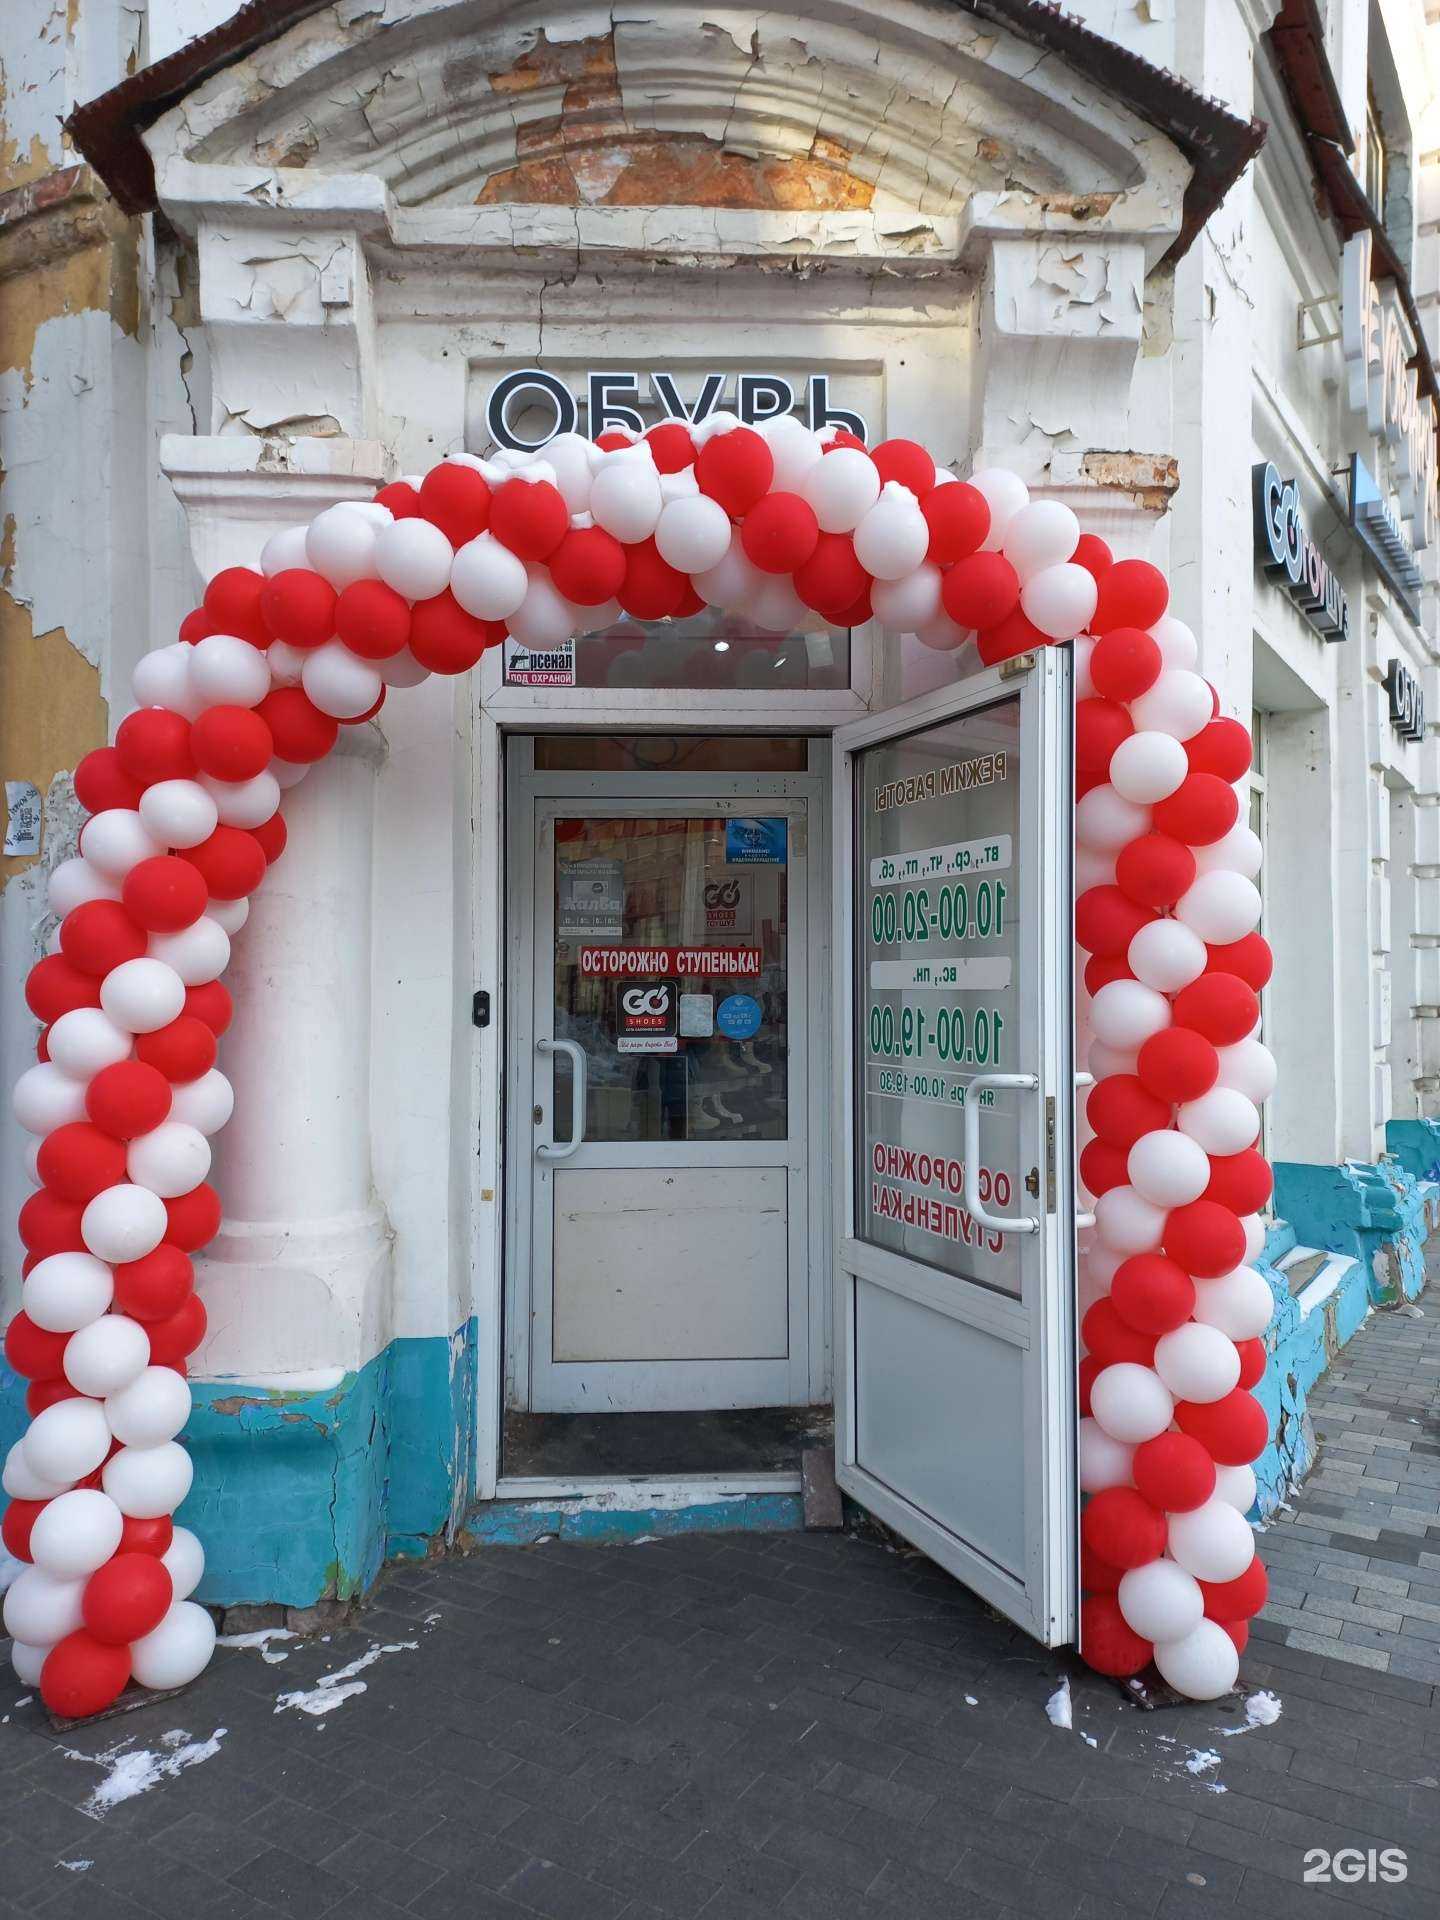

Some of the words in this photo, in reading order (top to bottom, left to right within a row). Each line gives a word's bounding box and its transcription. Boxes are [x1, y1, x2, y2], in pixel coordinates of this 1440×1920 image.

[486, 368, 868, 454] ОБУВЬ
[510, 673, 529, 685] ПОД
[531, 673, 572, 685] ОХРАНОЙ
[582, 950, 669, 973] ОСТОРОЖНО
[676, 950, 759, 974] СТУПЕНЬКА!
[622, 985, 669, 1016] GO
[629, 1018, 663, 1026] SHOES
